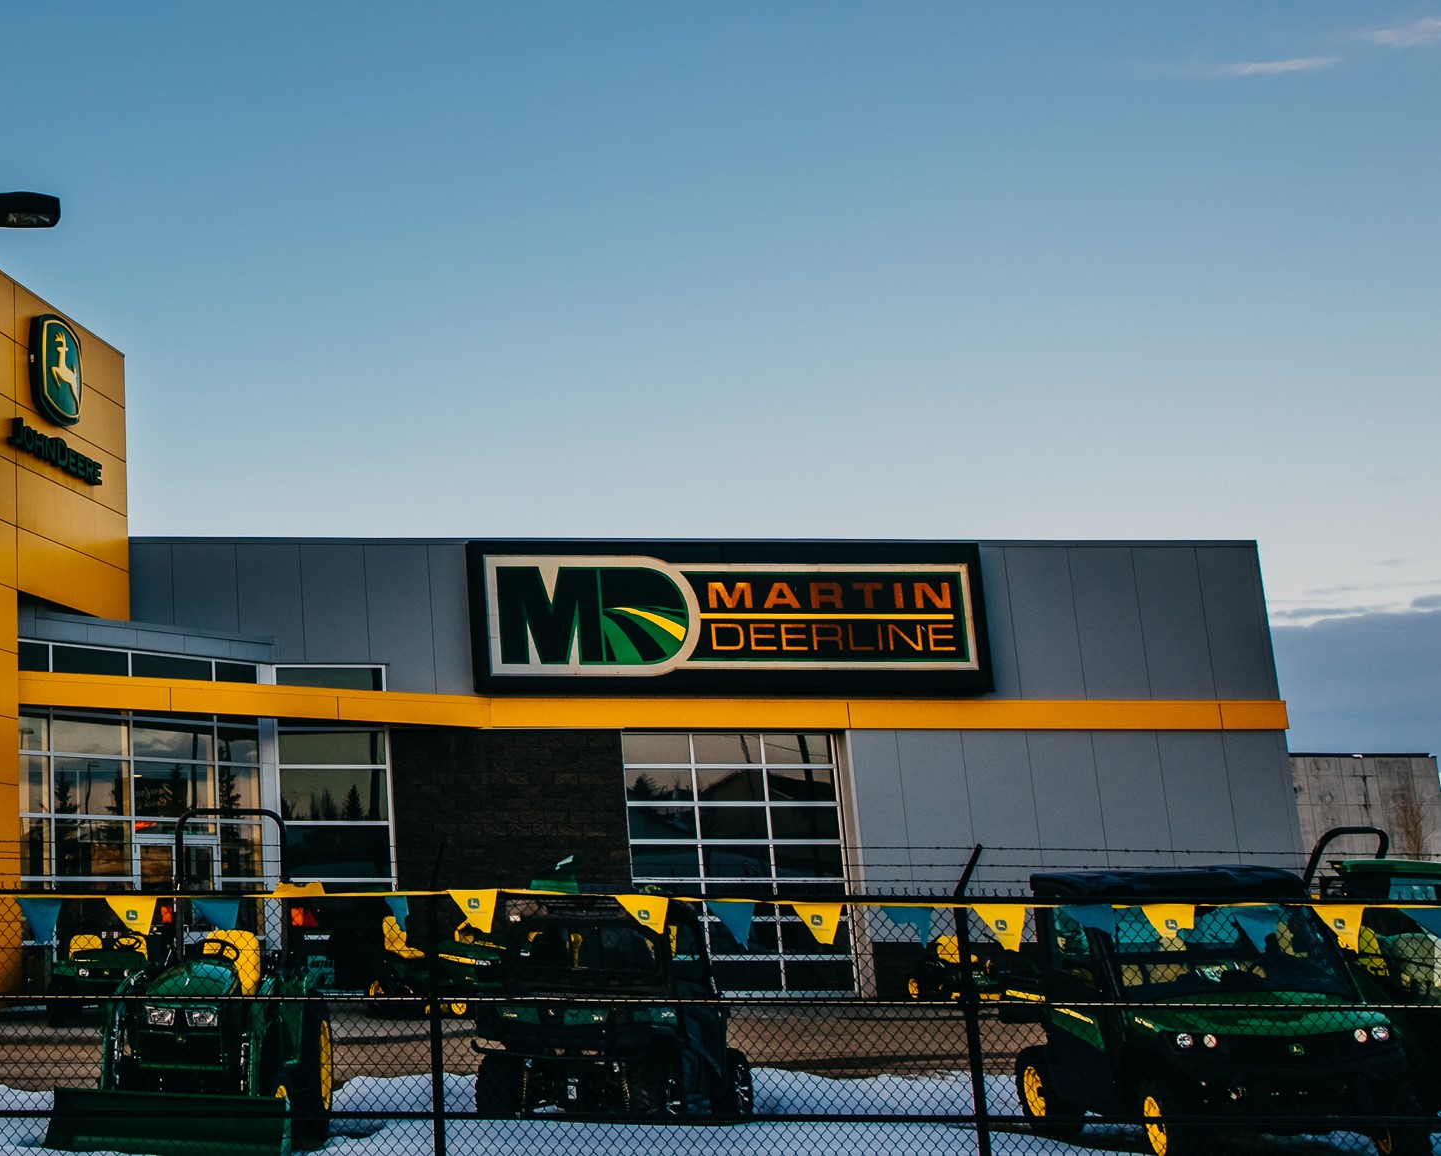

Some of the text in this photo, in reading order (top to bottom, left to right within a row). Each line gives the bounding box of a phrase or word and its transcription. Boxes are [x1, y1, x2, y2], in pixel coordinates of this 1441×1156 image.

[8, 417, 103, 486] JOHN DEERE
[707, 582, 953, 610] MARTIN
[710, 623, 957, 652] DEERLINE
